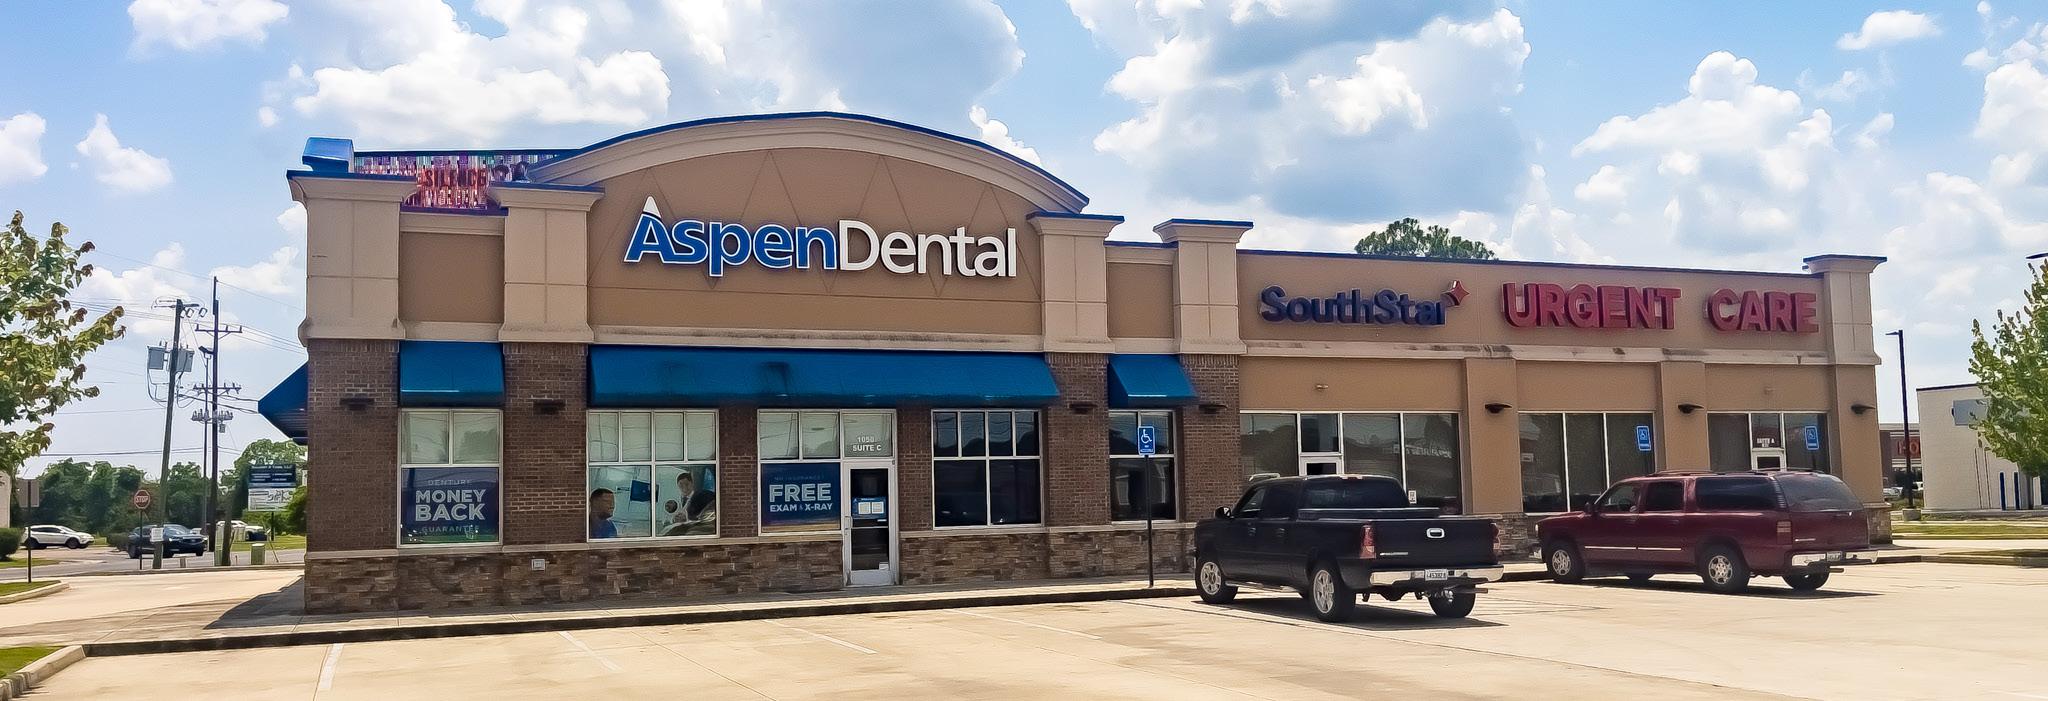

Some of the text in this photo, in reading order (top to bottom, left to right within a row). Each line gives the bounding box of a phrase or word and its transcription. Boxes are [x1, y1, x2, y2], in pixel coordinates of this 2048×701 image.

[1258, 284, 1446, 326] SouthStar
[1502, 283, 1820, 334] URGENT CARE
[135, 495, 149, 503] STOP
[415, 489, 487, 503] MONEY
[769, 483, 832, 502] FREE
[415, 503, 486, 521] BACK
[770, 504, 798, 512] EXAM
[805, 503, 833, 511] X-RAY
